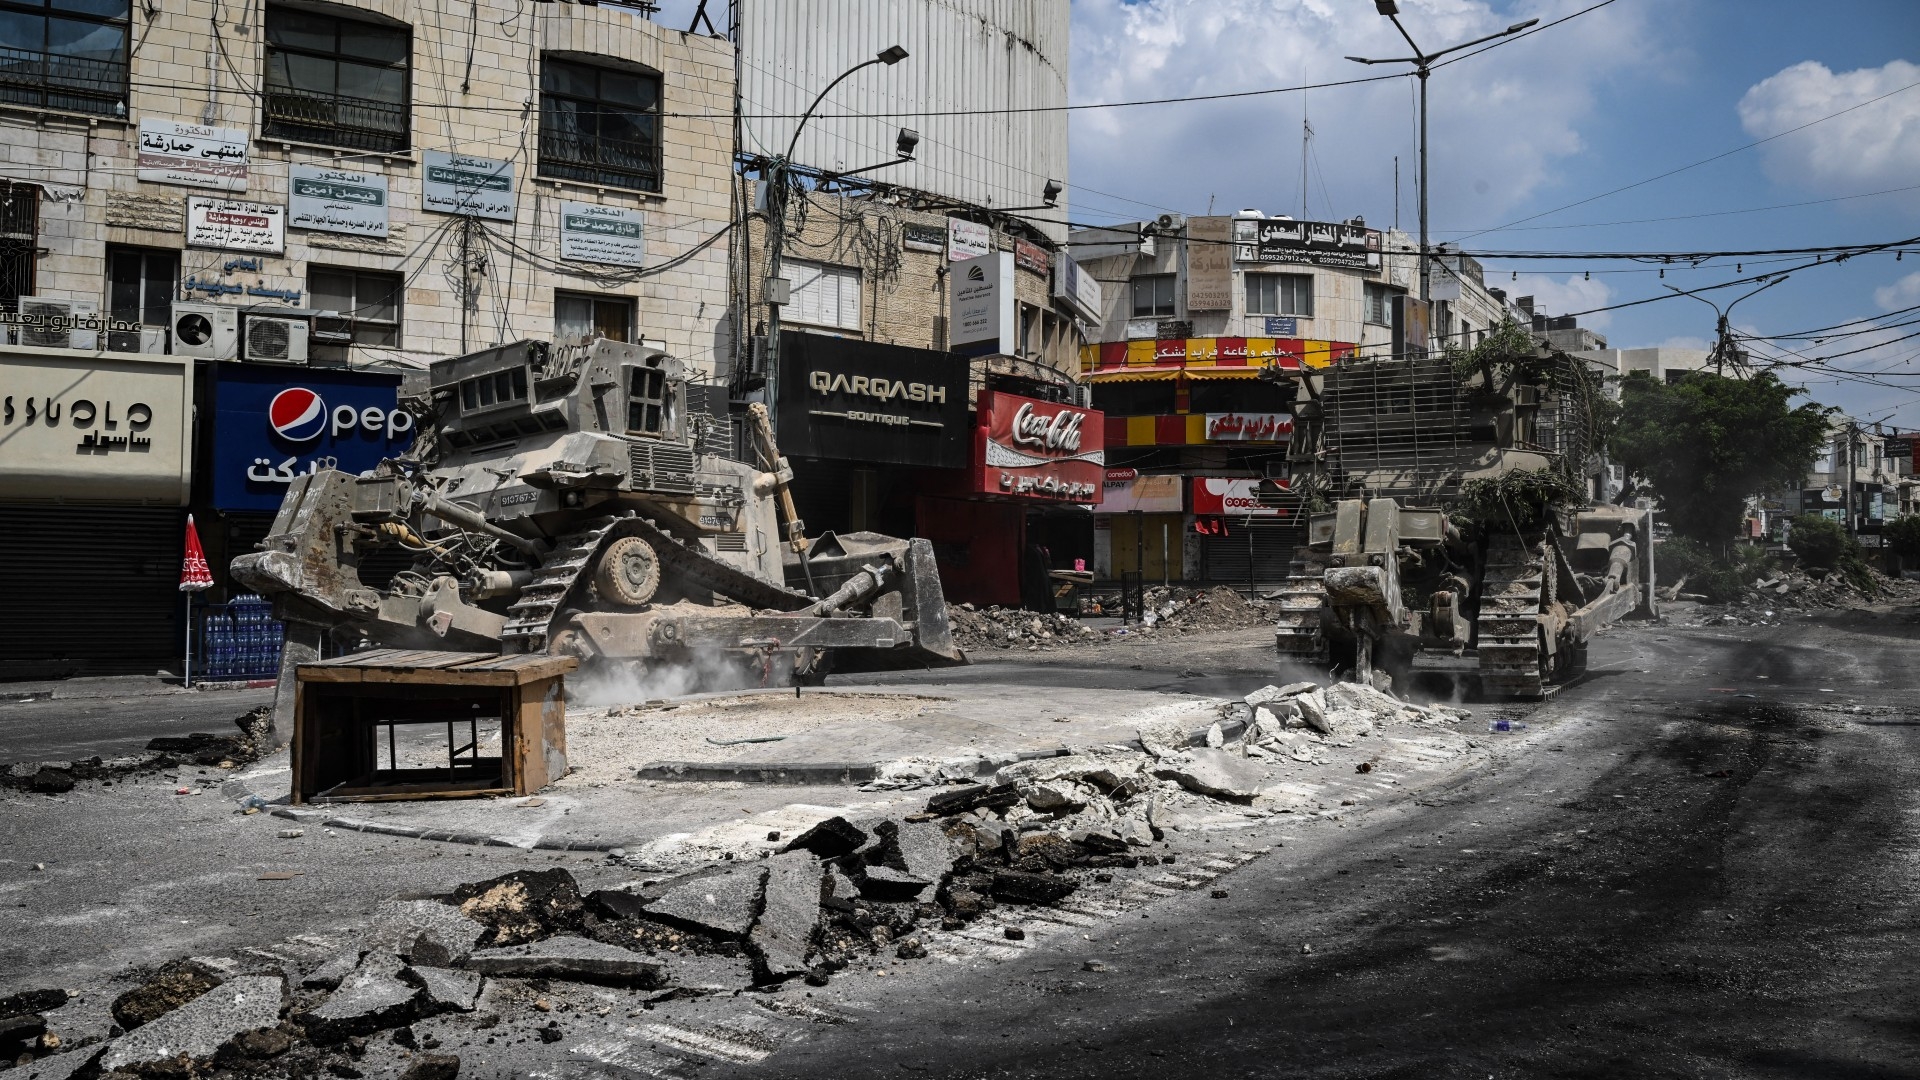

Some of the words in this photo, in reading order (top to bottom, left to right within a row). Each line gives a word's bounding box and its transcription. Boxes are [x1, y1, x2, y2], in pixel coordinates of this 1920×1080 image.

[175, 124, 214, 136] الدكتورة
[142, 133, 195, 152] حمارشة
[201, 145, 244, 159] منتهى
[447, 158, 493, 170] الدكتور
[315, 172, 366, 184] الدكتور
[335, 189, 377, 202] فيصل
[426, 194, 460, 209] والتناسلية
[194, 200, 216, 210] الهندسي
[217, 200, 244, 213] الاستشاري
[260, 205, 278, 216] مكتب
[460, 198, 485, 212] الجلدية
[486, 202, 511, 214] الامراض
[582, 206, 624, 218] الدكتور
[208, 212, 228, 222] حمارشة
[248, 218, 267, 226] المهندس
[293, 212, 313, 224] التنفسي
[570, 218, 592, 229] خلف
[592, 220, 615, 231] محمد
[616, 222, 636, 235] طارق
[1192, 220, 1226, 236] مكتبة
[194, 232, 210, 240] مرخص
[230, 236, 246, 244] مرخص
[1260, 223, 1304, 245] السعدي
[1304, 224, 1337, 245] المختار
[1338, 226, 1366, 248] ستائر
[1190, 256, 1230, 273] المباركة
[1260, 254, 1299, 262] 0595267912
[224, 256, 264, 276] المحامي
[246, 279, 302, 306] يوسف
[973, 282, 994, 294] فلسطين
[50, 314, 79, 333] ابو
[85, 312, 142, 335] عمارة
[1152, 346, 1186, 360] تشكن
[1190, 346, 1218, 360] فرايد
[809, 371, 945, 404] QARQASH
[332, 404, 413, 440] pep
[847, 410, 910, 426] BOUTIQUE
[1210, 413, 1244, 437] تشكن
[1012, 402, 1087, 451] Coca-Cola
[1245, 415, 1275, 439] فرايد
[1108, 470, 1133, 478] ooredoo
